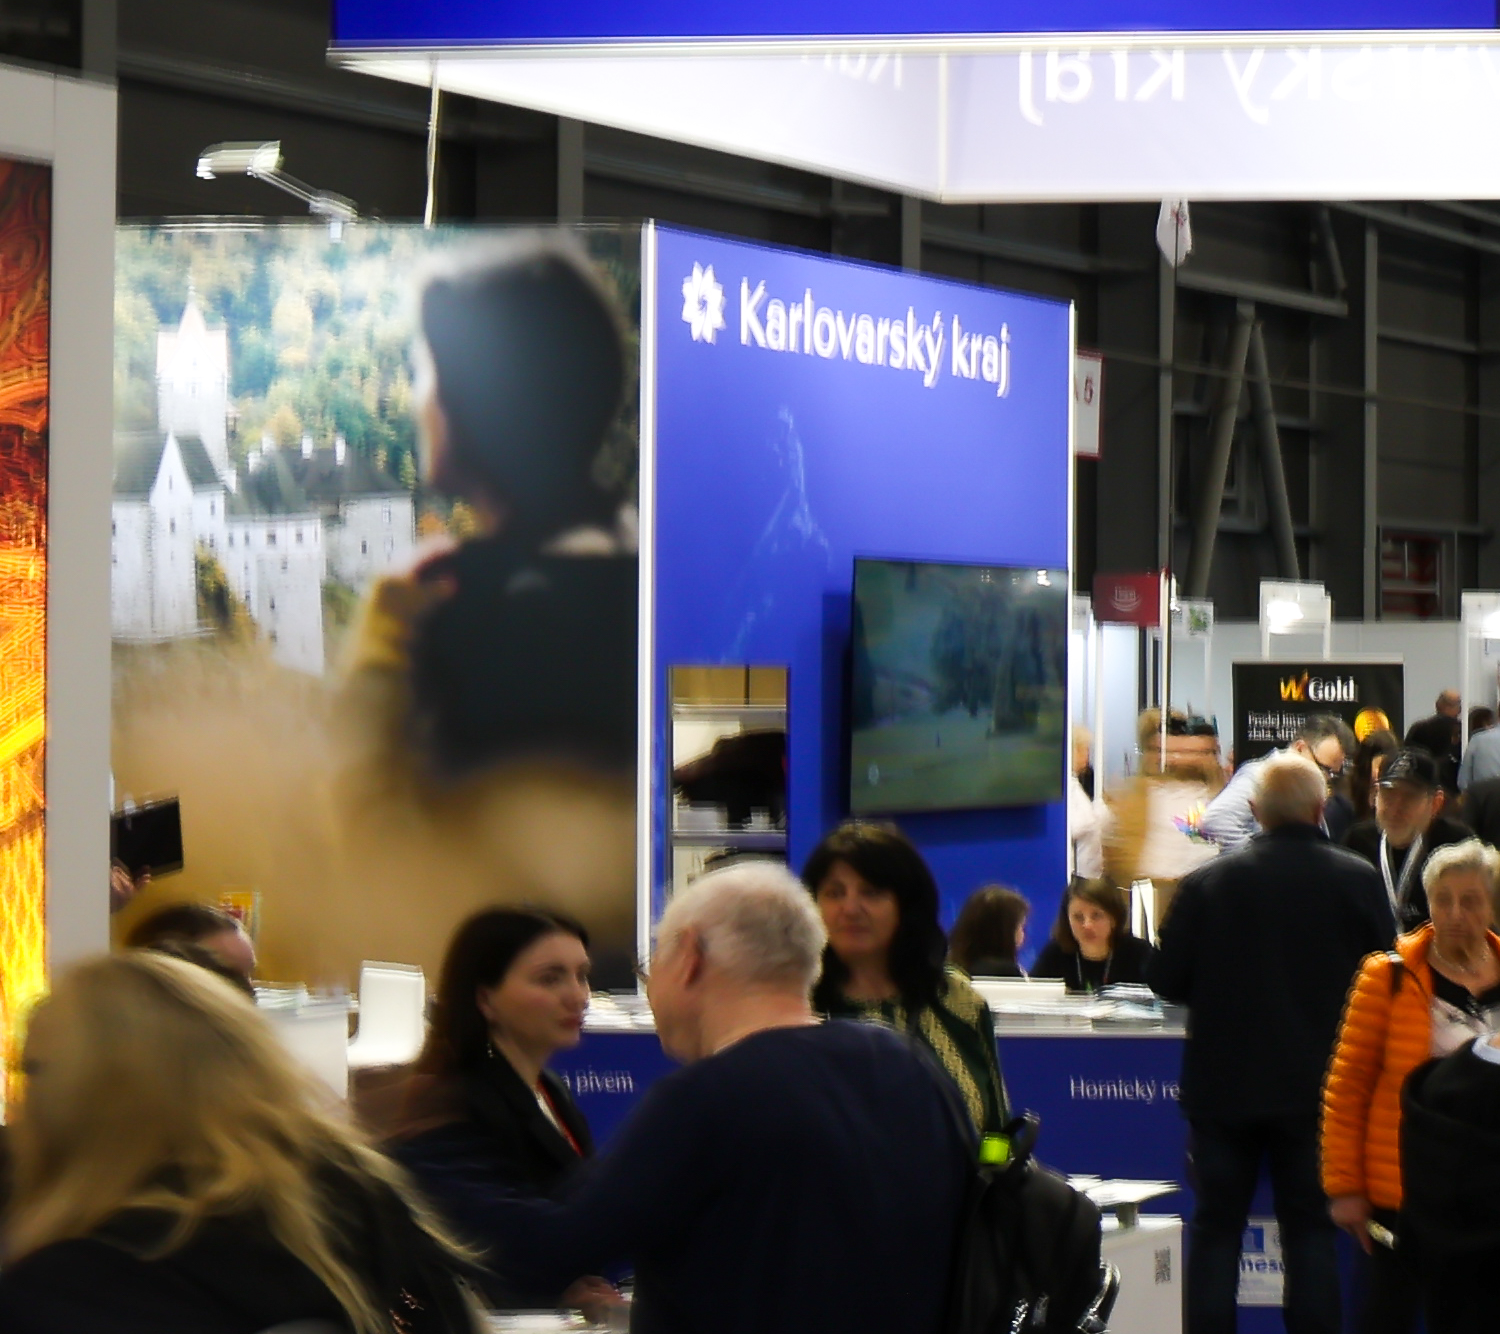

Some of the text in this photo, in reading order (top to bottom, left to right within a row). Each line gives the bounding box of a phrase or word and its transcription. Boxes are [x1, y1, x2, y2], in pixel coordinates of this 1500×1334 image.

[739, 276, 1011, 399] Karlovarský kraj
[1308, 675, 1358, 703] Gold
[576, 1069, 634, 1096] pivem
[1070, 1074, 1156, 1105] Hornický
